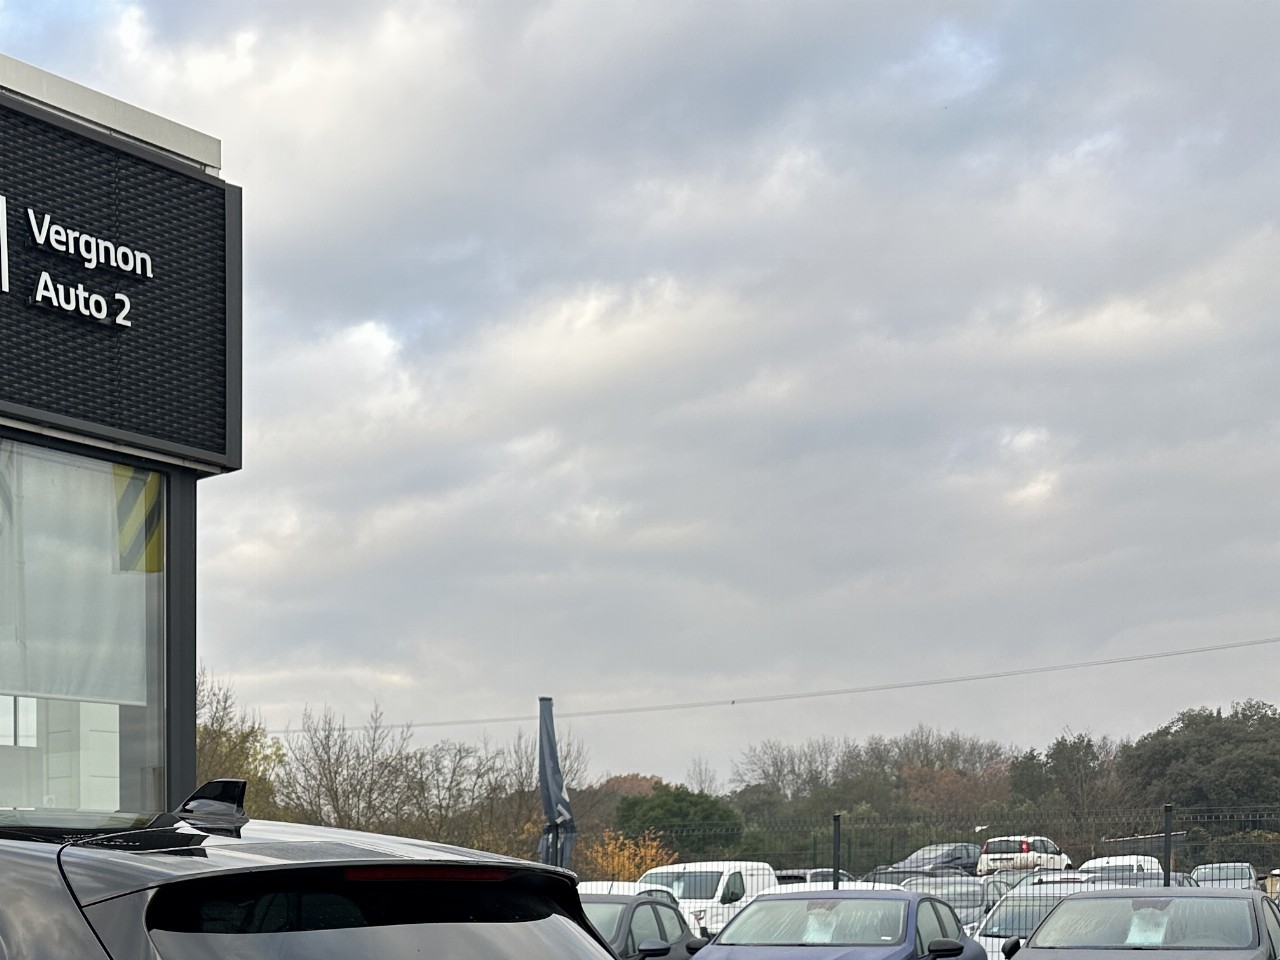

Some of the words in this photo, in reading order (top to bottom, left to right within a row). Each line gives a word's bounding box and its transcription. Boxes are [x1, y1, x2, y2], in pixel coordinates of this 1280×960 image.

[27, 208, 153, 278] Vergnon
[35, 271, 108, 320] Auto
[114, 293, 132, 327] 2
